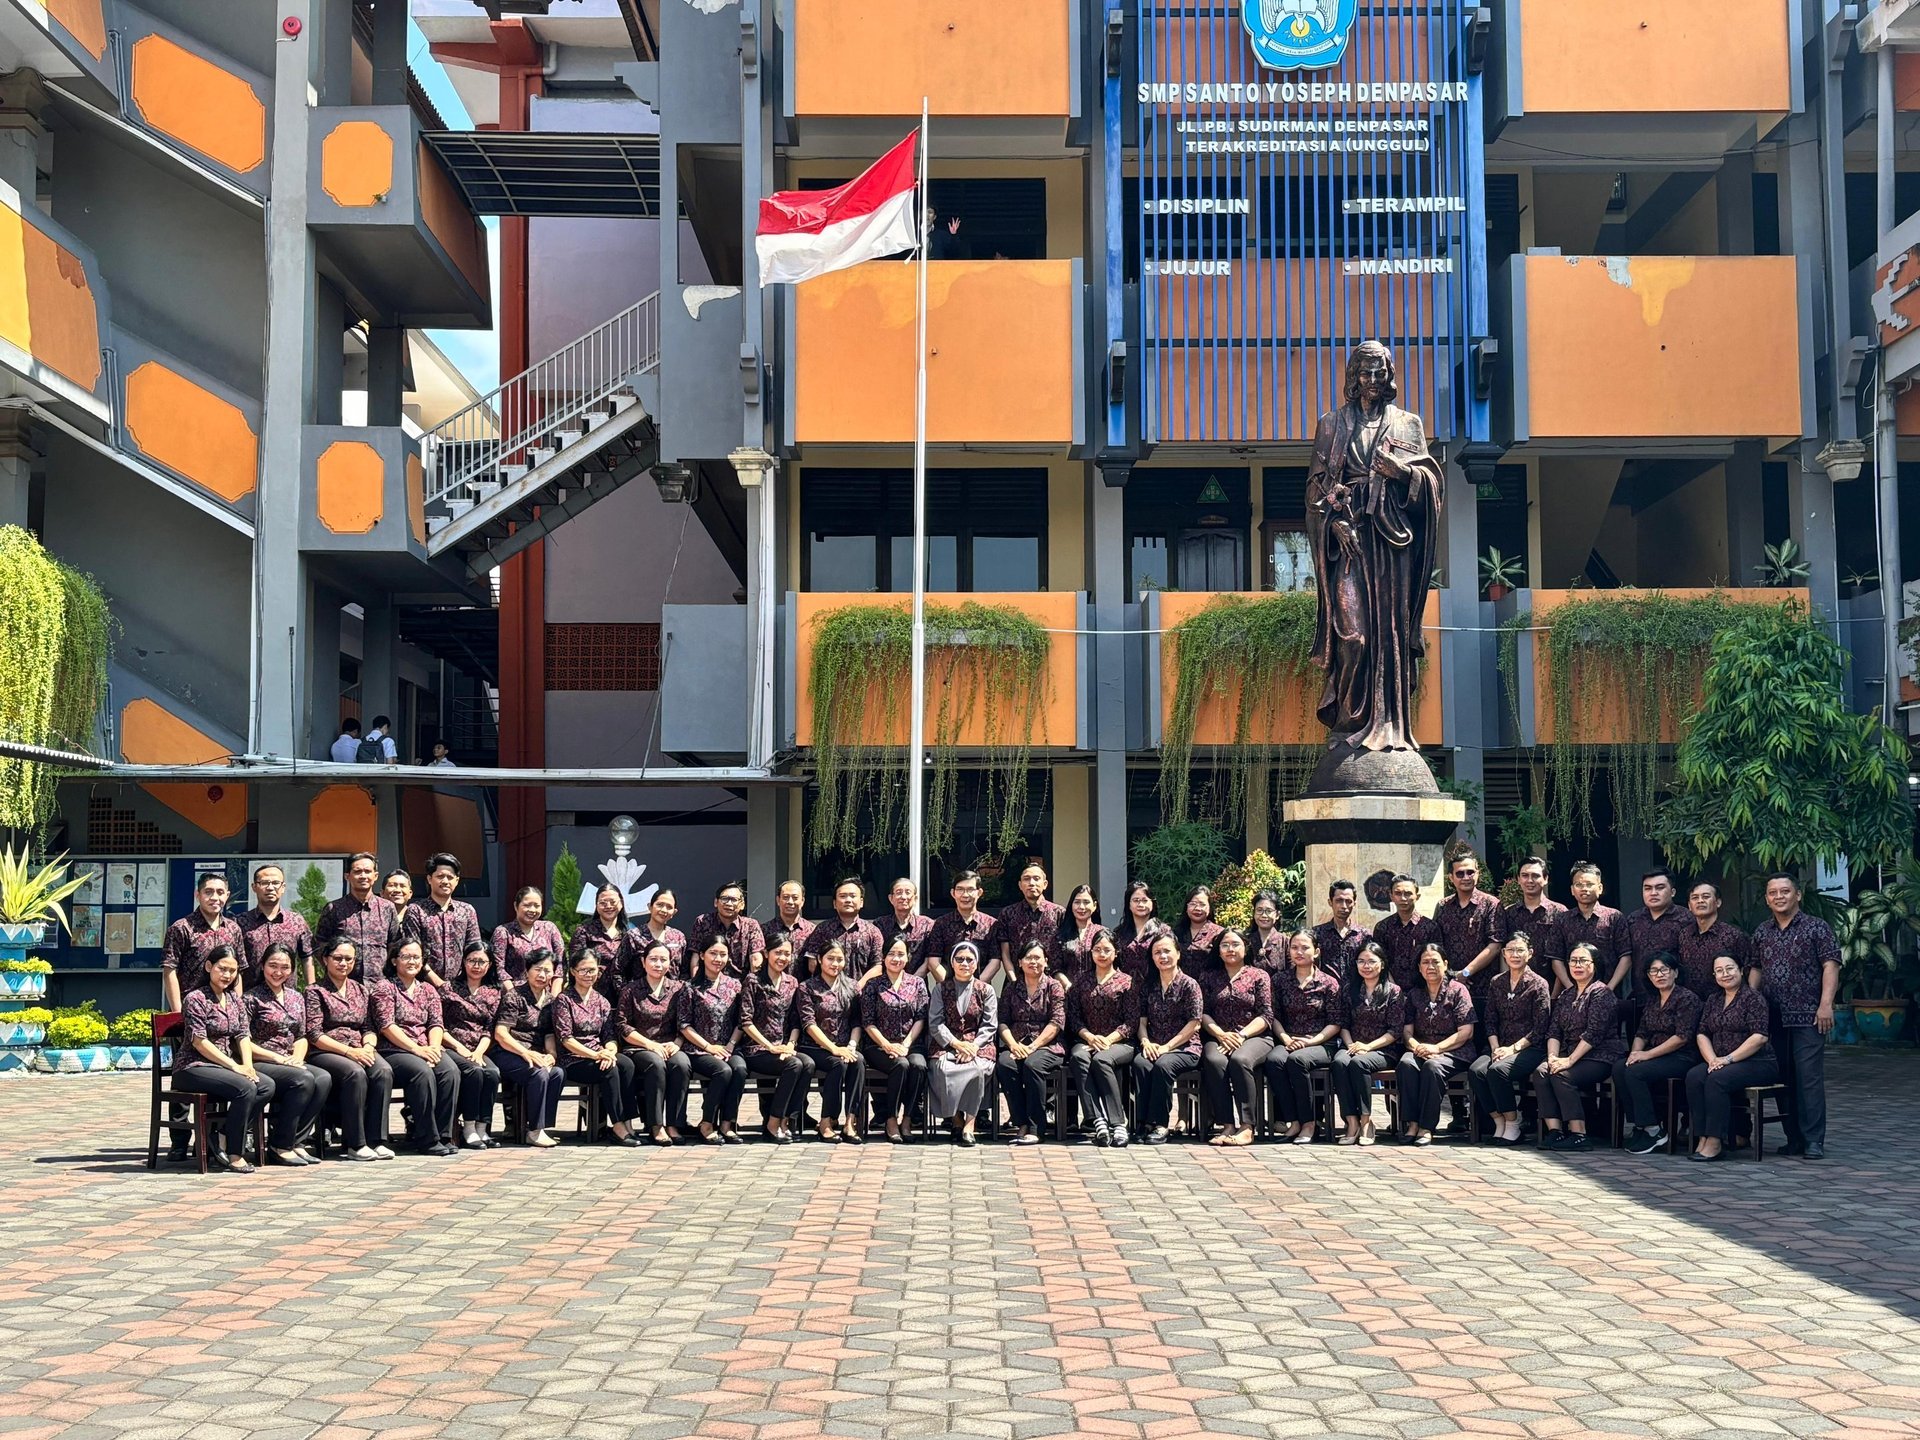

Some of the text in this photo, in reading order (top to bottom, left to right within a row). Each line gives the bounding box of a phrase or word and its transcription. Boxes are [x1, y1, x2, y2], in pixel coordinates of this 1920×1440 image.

[1138, 81, 1468, 103] SMP SANTO YOSEPH DENPASAR
[1238, 120, 1329, 133] SUDIRMAN
[1334, 119, 1429, 132] DENPASAR
[1186, 140, 1326, 153] TERAKREDITASI
[1346, 137, 1430, 152] (UNGGUL)
[1159, 198, 1250, 214] DISIPLIN
[1356, 196, 1467, 213] TERAMPIL
[1160, 260, 1231, 276] JUJUR
[1360, 258, 1454, 275] MANDIRI
